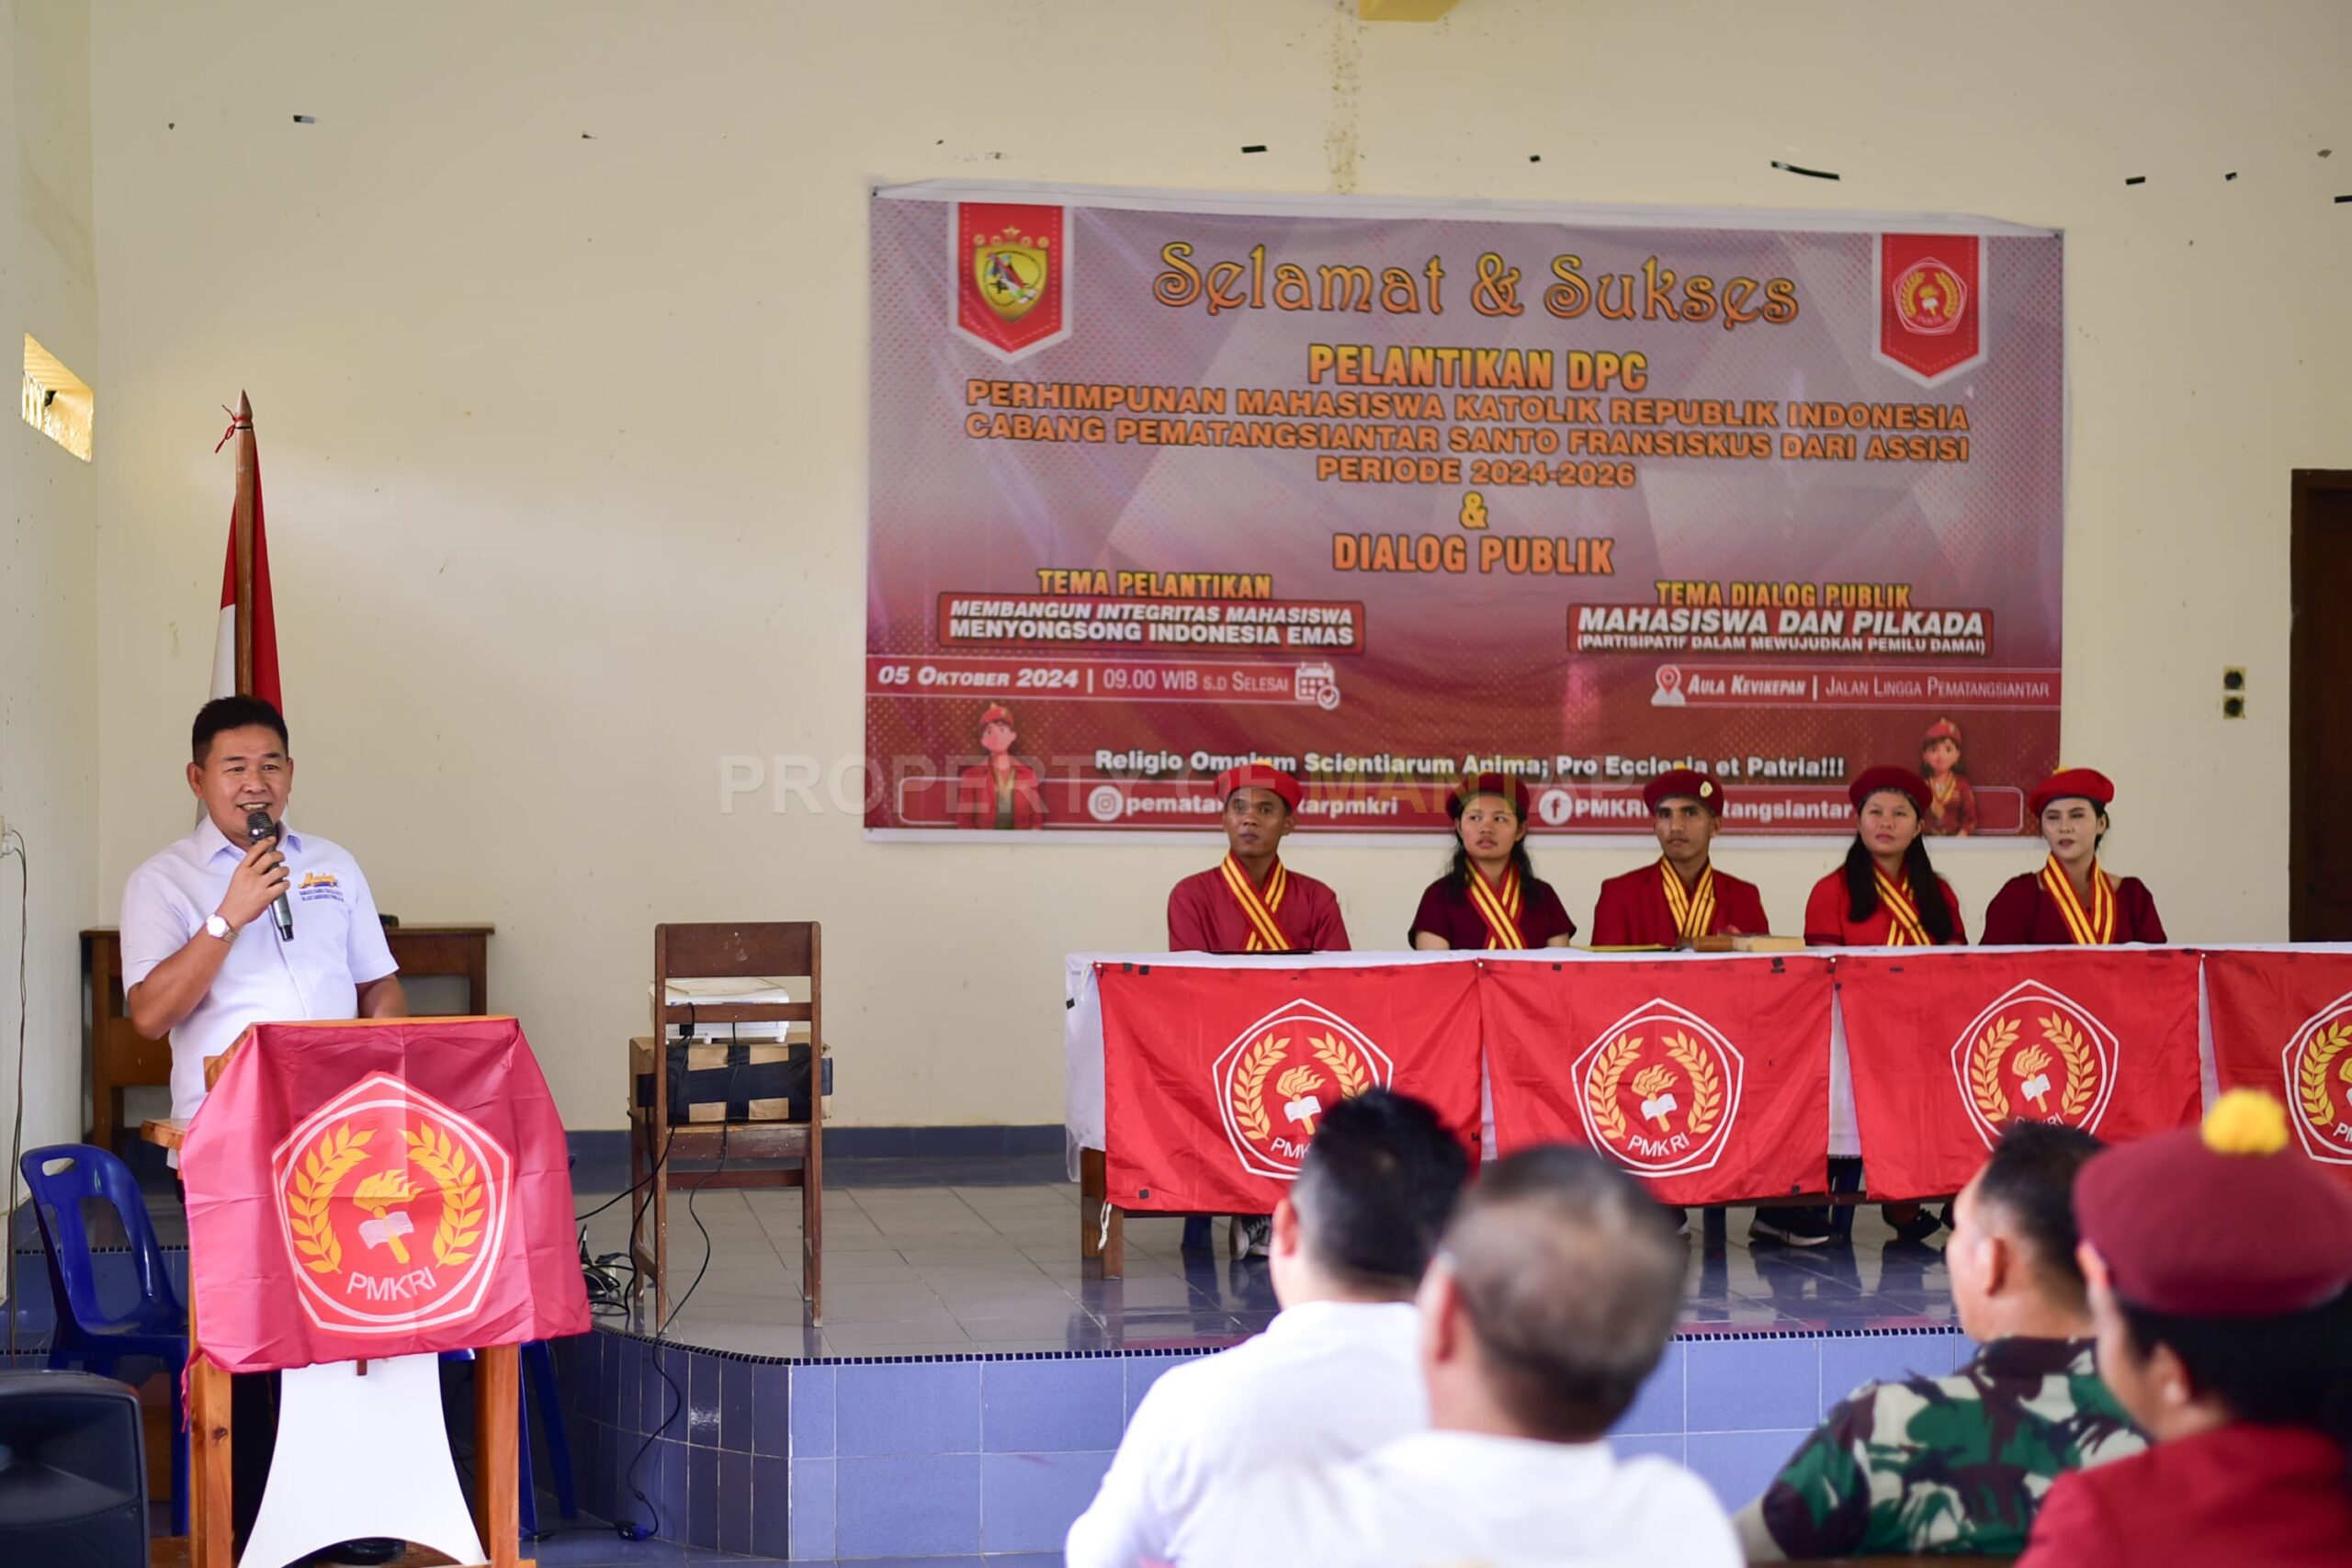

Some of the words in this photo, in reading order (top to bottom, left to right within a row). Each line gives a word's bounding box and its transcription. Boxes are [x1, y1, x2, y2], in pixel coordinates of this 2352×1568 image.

[1153, 242, 1443, 315] Selamat
[1471, 252, 1524, 317] &
[1544, 254, 1799, 331] Sukses
[1308, 344, 1553, 389] PELANTIKAN
[1566, 350, 1648, 391] DPC
[966, 378, 1226, 414] PERHIMPUNAN
[1236, 389, 1443, 421] MAHASISWA
[1454, 395, 1600, 424] KATOLIK
[1609, 400, 1779, 429] REPUBLIK
[1788, 403, 1970, 431] INDONESIA
[965, 412, 1105, 444] CABANG
[1115, 417, 1439, 452] PEMATANGSIANTAR
[1449, 427, 1559, 455] SANTO
[1567, 430, 1771, 458] FRANSISKUS
[1781, 434, 1856, 460] DARI
[1865, 436, 1970, 462] ASSISI
[1317, 456, 1462, 484] PERIODE
[1471, 459, 1635, 487] 2024-2026
[1459, 491, 1487, 530] &
[1332, 533, 1466, 573] DIALOG
[1479, 535, 1614, 575] PUBLIK
[1036, 570, 1105, 595] TEMA
[1117, 570, 1272, 599] PELANTIKAN
[1654, 581, 1723, 607] TEMA
[1731, 582, 1817, 608] DIALOG
[1825, 584, 1913, 610] PUBLIK
[950, 600, 1091, 620] MEMBANGUN
[1096, 603, 1220, 623] INTEGRITAS
[1226, 605, 1352, 626] MAHASISWA
[1577, 607, 1769, 635] MAHASISWA
[1778, 610, 1844, 636] DAN
[1852, 612, 1984, 637] PILKADA
[949, 619, 1142, 642] MENYONGSONG
[1148, 624, 1281, 644] INDONESIA
[1287, 626, 1354, 646] EMAS
[1577, 634, 1687, 650] (PARTISIPATIF
[1691, 635, 1746, 650] DALAM
[1751, 636, 1863, 652] MEWUJUDKAN
[1868, 637, 1927, 653] PEMILU
[1930, 637, 1985, 656] DAMAI)
[878, 666, 910, 685] 05
[1017, 669, 1079, 688] 2024
[1103, 669, 1156, 691] 09.00
[1162, 671, 1197, 691] WIB
[1094, 750, 1185, 772] Religio
[1305, 752, 1455, 773] Scientiarum
[1556, 755, 1598, 775] Pro
[1716, 757, 1740, 776] et
[1747, 756, 1845, 777] Patria!!!
[1627, 1132, 1690, 1157] PMKRI
[346, 1267, 436, 1302] PMKRI
